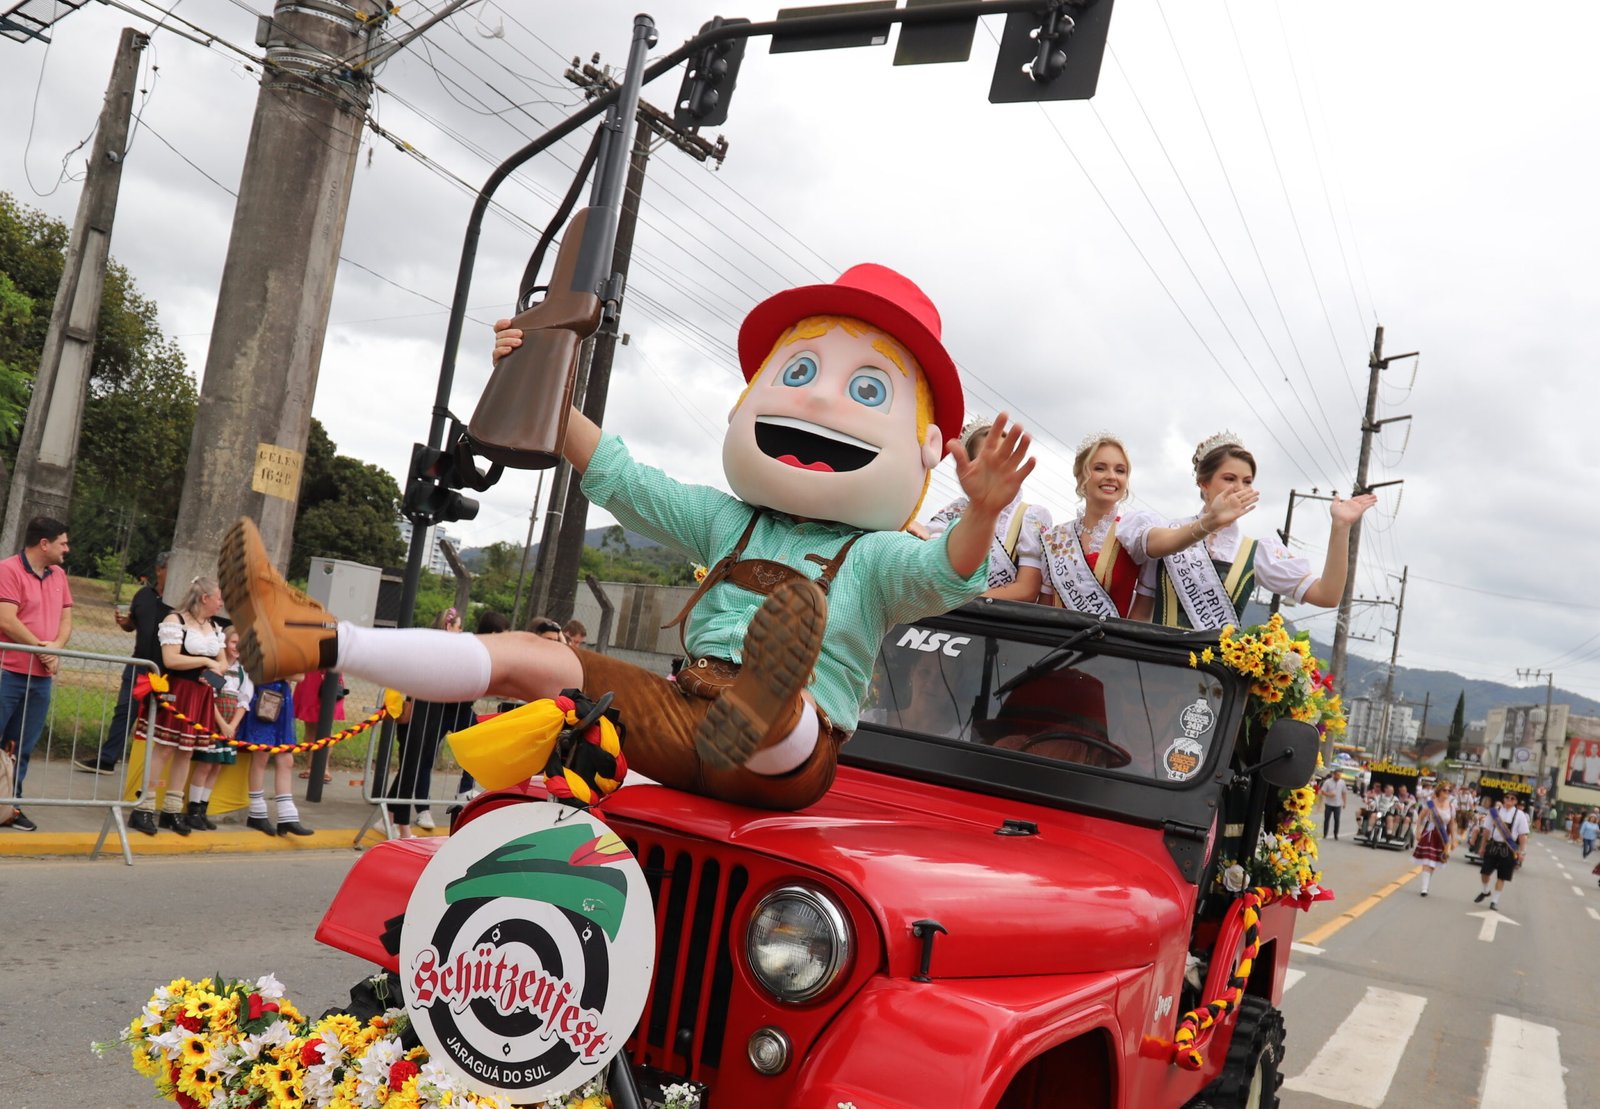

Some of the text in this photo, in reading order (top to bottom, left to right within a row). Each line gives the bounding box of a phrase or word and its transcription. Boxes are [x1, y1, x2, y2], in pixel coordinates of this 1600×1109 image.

[260, 450, 299, 468] CELES
[896, 627, 971, 657] NSC
[413, 947, 608, 1058] Schützenfest
[446, 1036, 551, 1083] JARAGUÁ DO SUL
